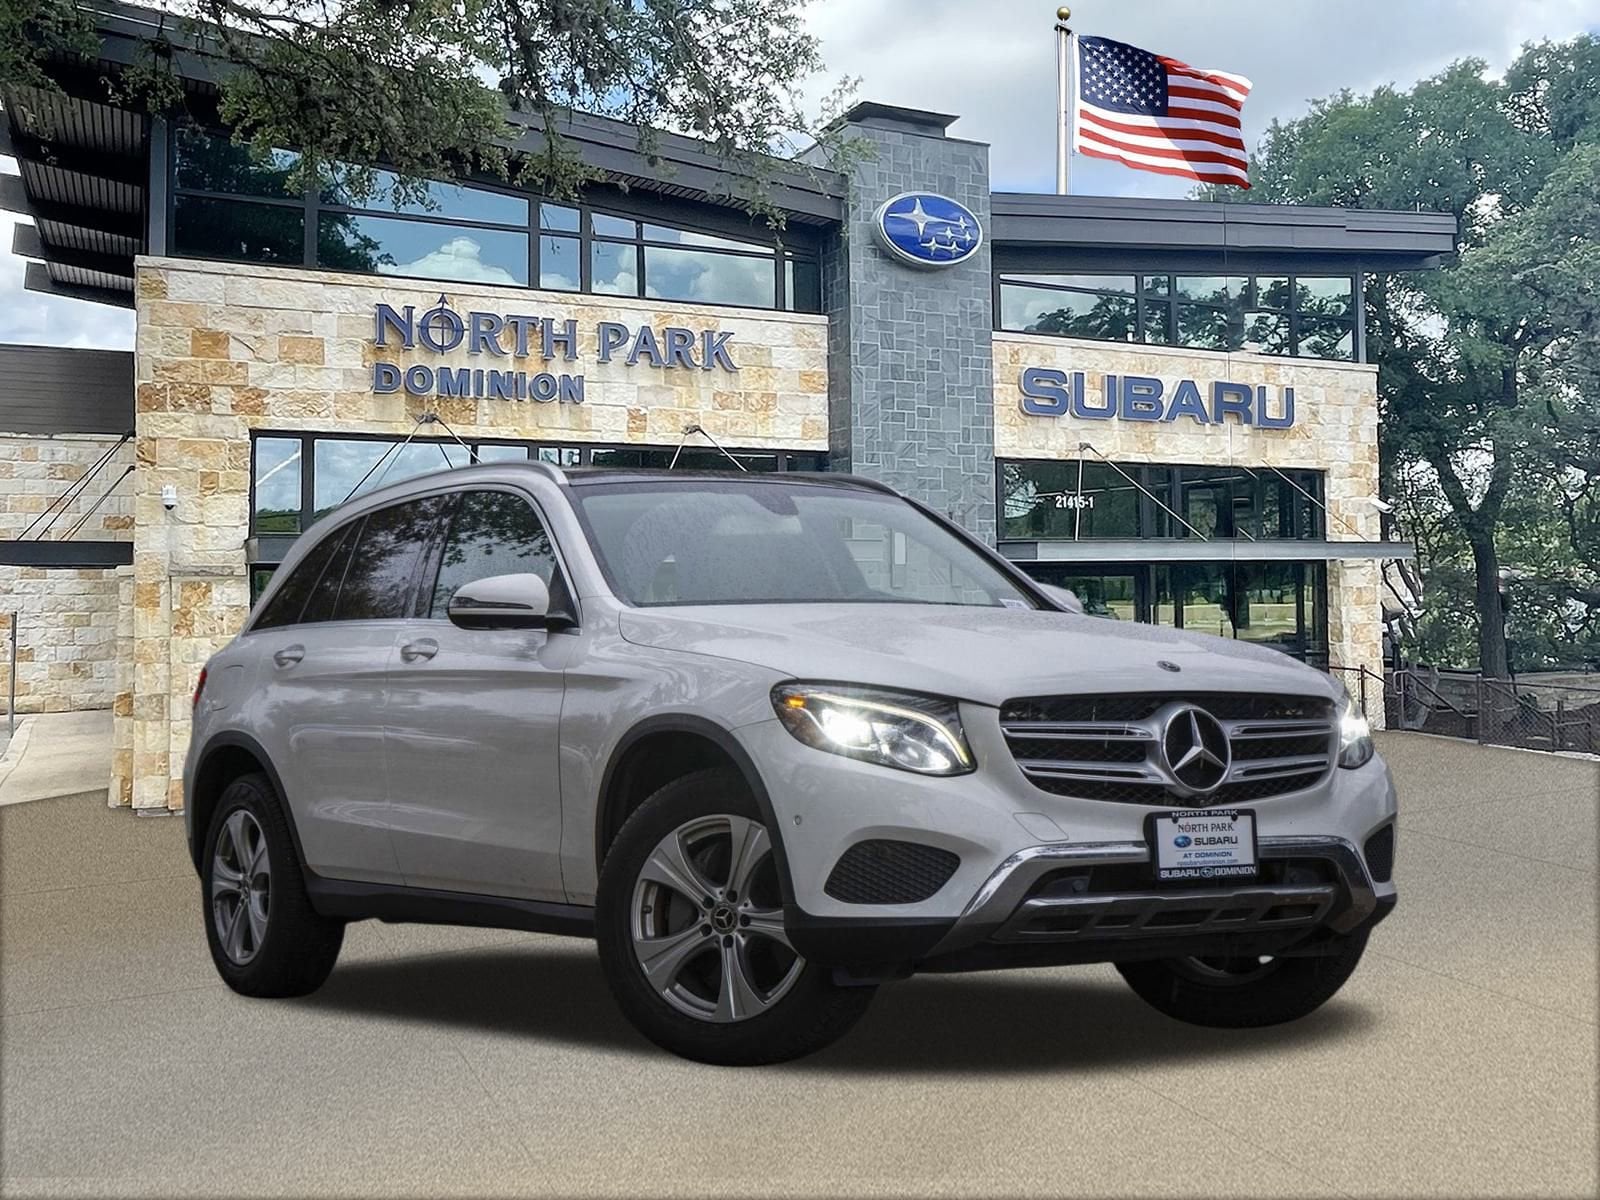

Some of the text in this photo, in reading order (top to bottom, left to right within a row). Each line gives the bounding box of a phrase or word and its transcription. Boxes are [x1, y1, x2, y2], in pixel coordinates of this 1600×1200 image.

[375, 293, 740, 373] NORTH PARK
[373, 361, 585, 405] DOMINION
[1019, 367, 1295, 429] SUBARU
[1055, 495, 1094, 509] 21415-1
[1211, 809, 1239, 817] PARK
[1178, 821, 1234, 833] NORTH PARK
[1194, 836, 1238, 846] SUBARU
[1195, 851, 1232, 859] DOMINION
[1160, 866, 1257, 879] SUBARU DOMINION
